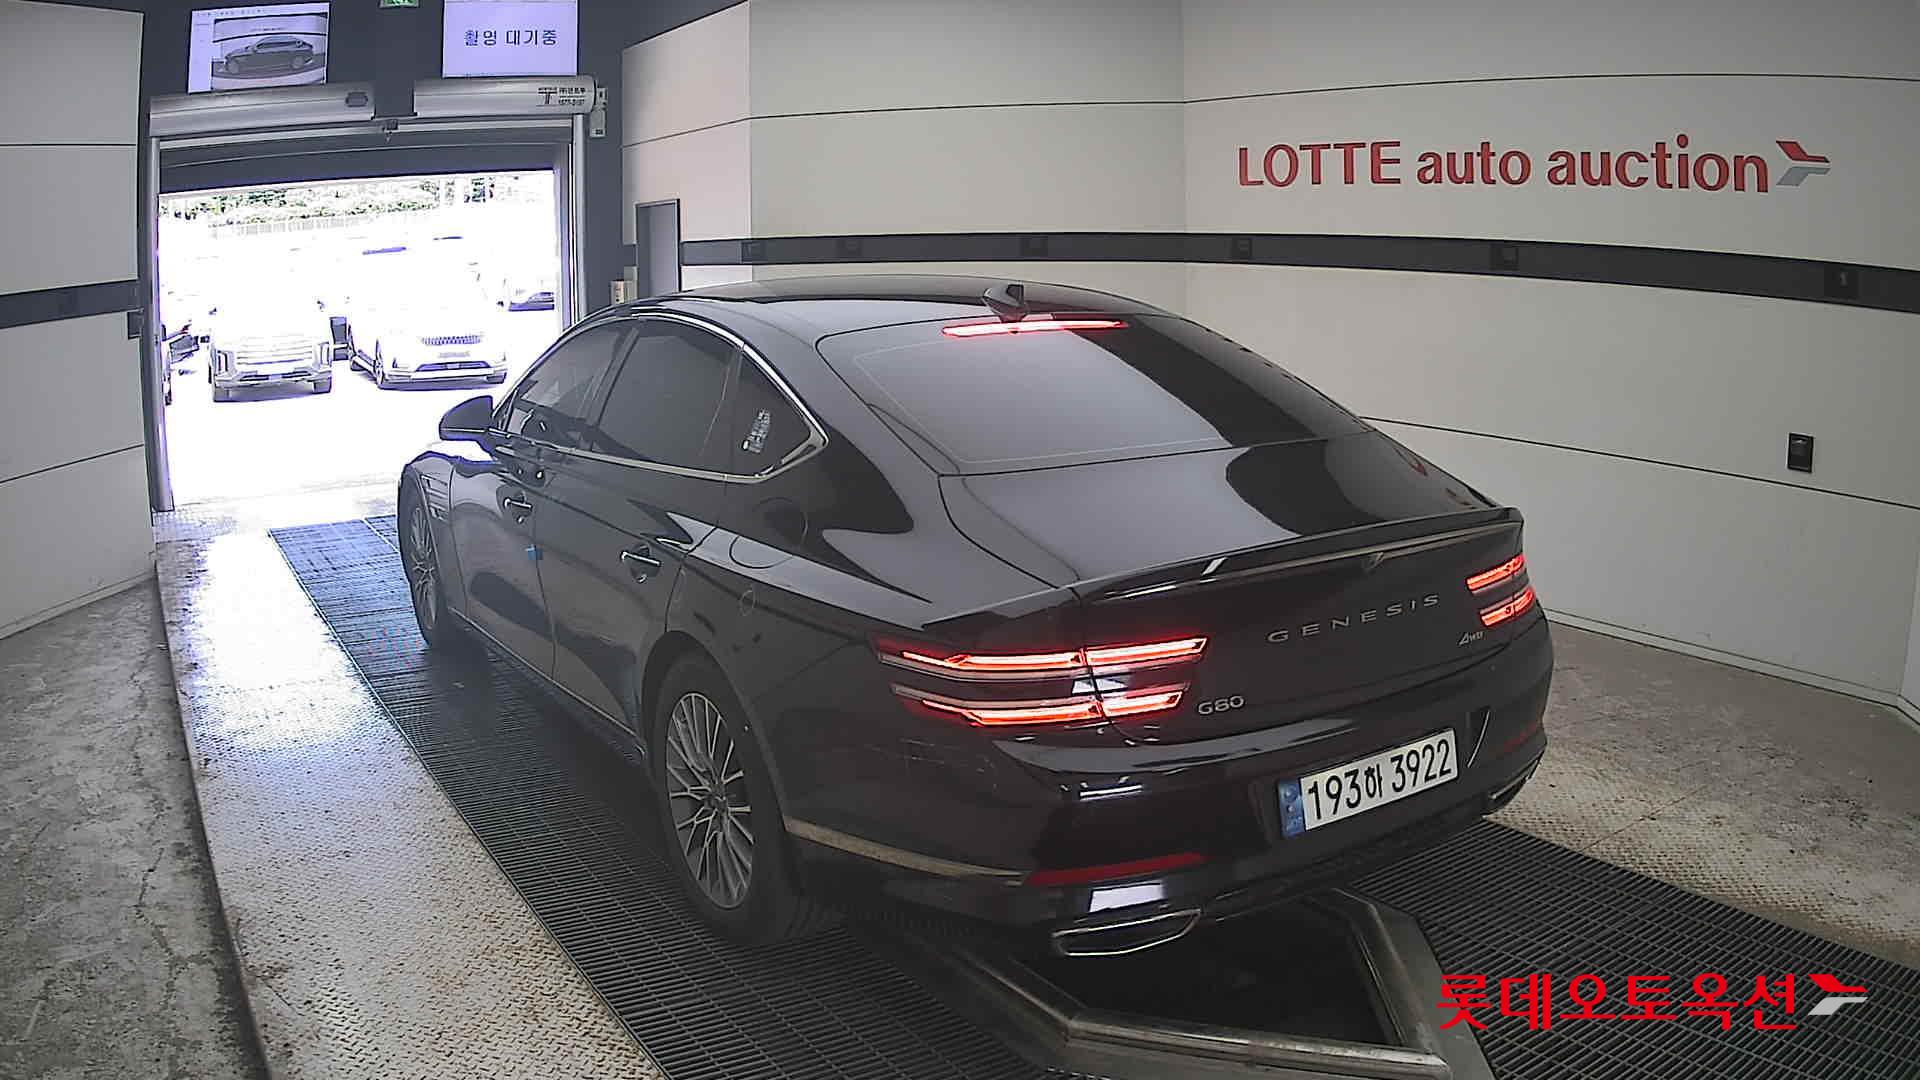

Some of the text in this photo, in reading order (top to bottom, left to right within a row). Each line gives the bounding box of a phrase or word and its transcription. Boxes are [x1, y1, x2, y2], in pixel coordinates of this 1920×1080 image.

[505, 29, 557, 46] 대기중
[1238, 133, 1769, 193] LOTTE auto auction
[1266, 594, 1440, 643] GENESIS
[1198, 696, 1244, 715] G80
[1308, 739, 1452, 820] 193하 3922
